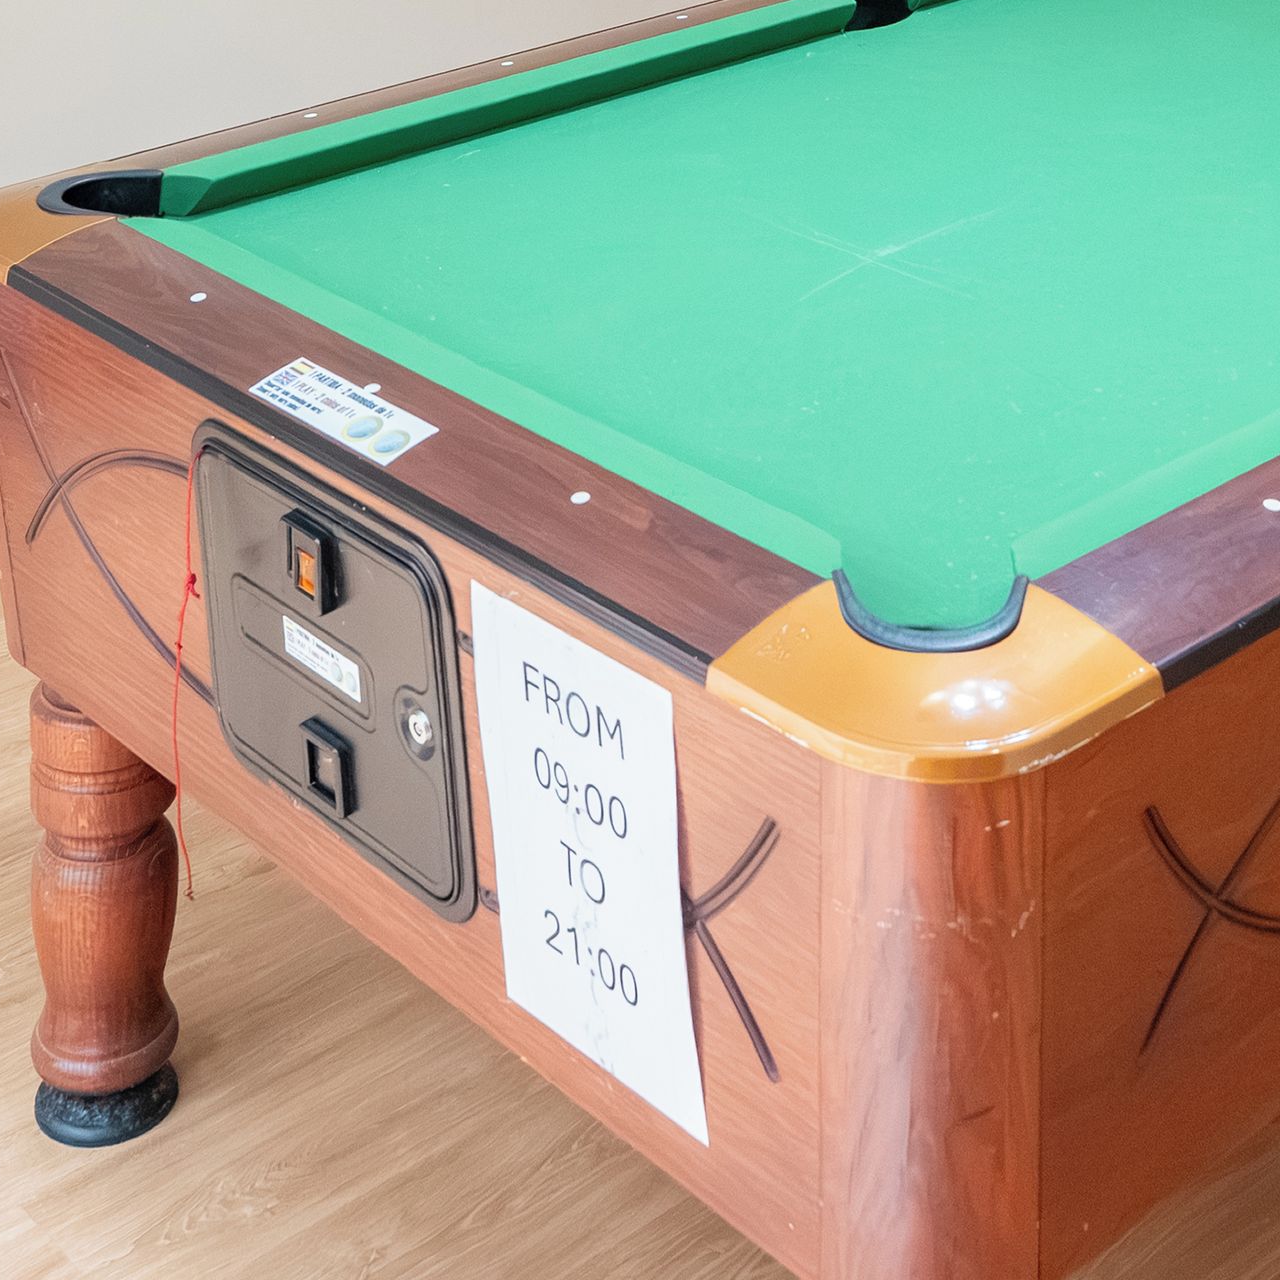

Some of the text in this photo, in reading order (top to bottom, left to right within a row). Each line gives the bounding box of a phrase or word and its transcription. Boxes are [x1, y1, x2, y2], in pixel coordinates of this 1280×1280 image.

[297, 382, 315, 396] PLAY
[521, 660, 625, 761] FROM
[533, 747, 628, 839] 09:00
[559, 839, 606, 905] TO
[544, 909, 639, 1007] 21:00
